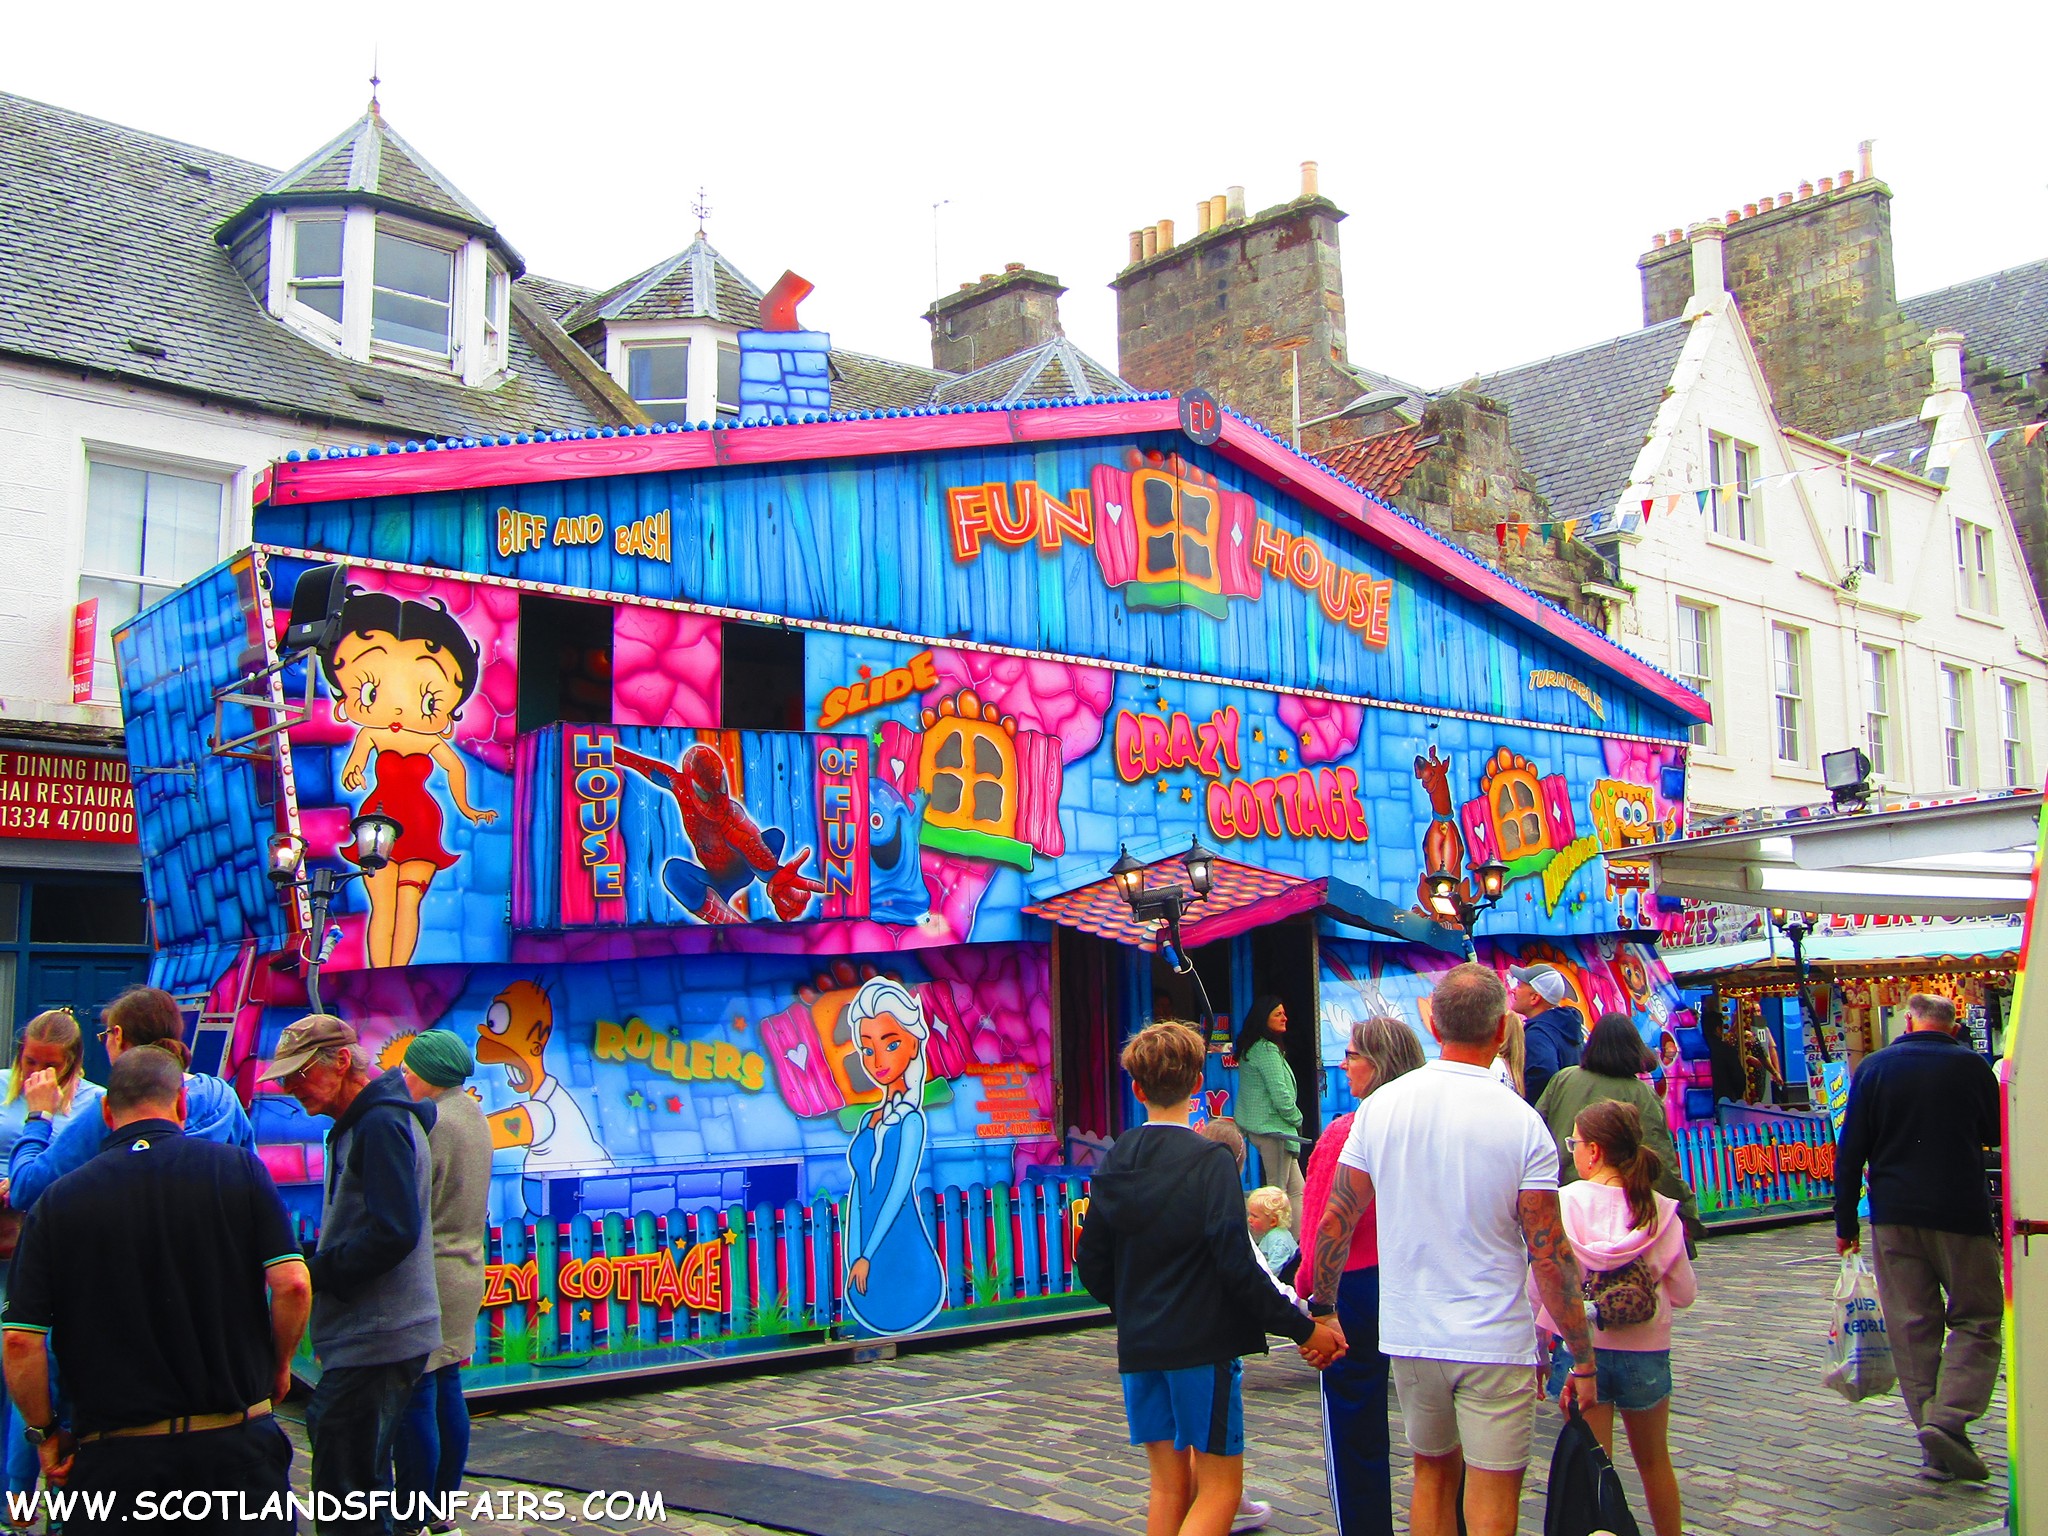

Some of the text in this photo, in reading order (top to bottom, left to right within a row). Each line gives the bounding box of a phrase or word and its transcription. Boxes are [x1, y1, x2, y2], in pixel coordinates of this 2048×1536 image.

[497, 506, 671, 563] BIFF AND BASH
[948, 480, 1393, 646] FUN HOUSE
[817, 650, 938, 729] SLIDE
[1528, 669, 1606, 722] TURNTABLE
[17, 755, 87, 780] DINING
[819, 747, 858, 776] OF
[1116, 705, 1240, 782] CRAZY
[37, 782, 135, 809] RESTAURA
[57, 809, 133, 834] 470000
[573, 734, 622, 897] HOUSE
[1207, 766, 1369, 841] COTTAGE
[823, 785, 856, 896] FUN
[594, 1017, 765, 1090] ROLLERS
[1734, 1143, 1774, 1182] FUN
[558, 1238, 721, 1312] COTTAGE
